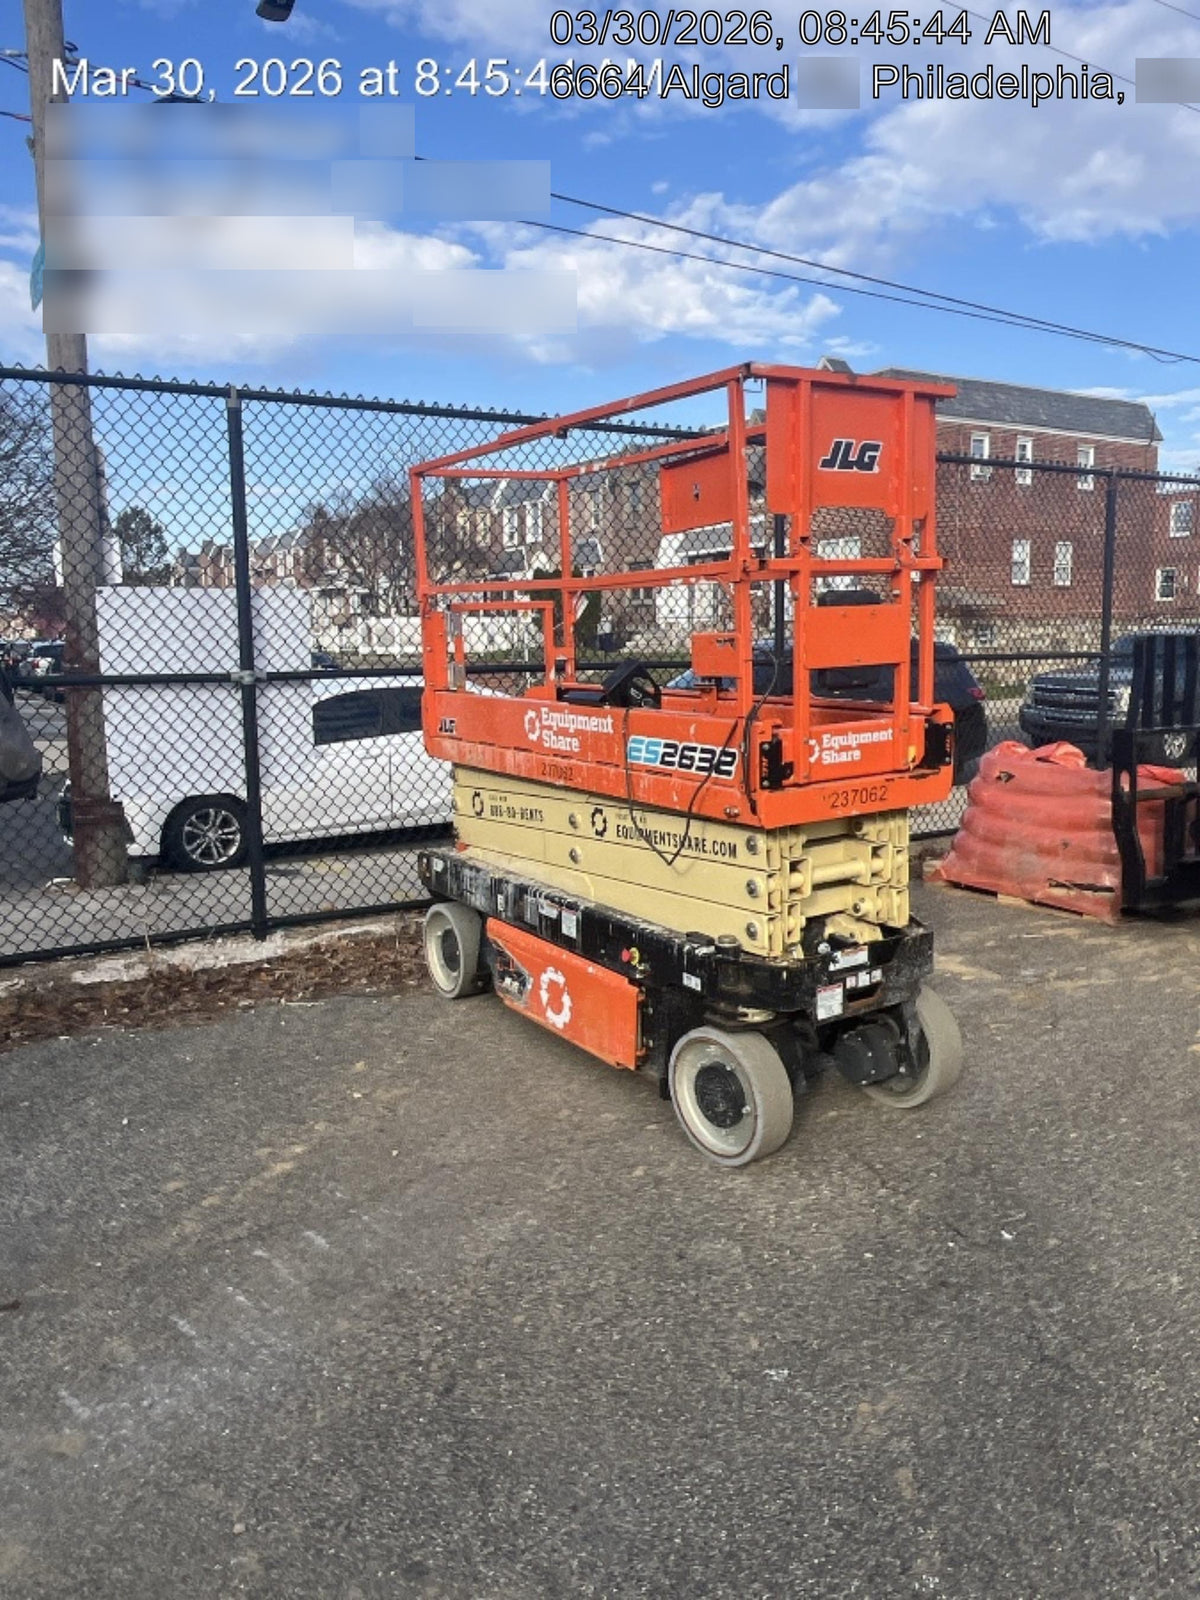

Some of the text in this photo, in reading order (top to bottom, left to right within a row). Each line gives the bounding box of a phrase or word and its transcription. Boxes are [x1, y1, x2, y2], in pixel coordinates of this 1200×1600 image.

[818, 438, 883, 473] JLG
[541, 707, 614, 734] Equipment
[542, 729, 581, 752] Share
[822, 727, 893, 750] Equipment
[822, 749, 861, 766] Share
[830, 785, 888, 808] 237062
